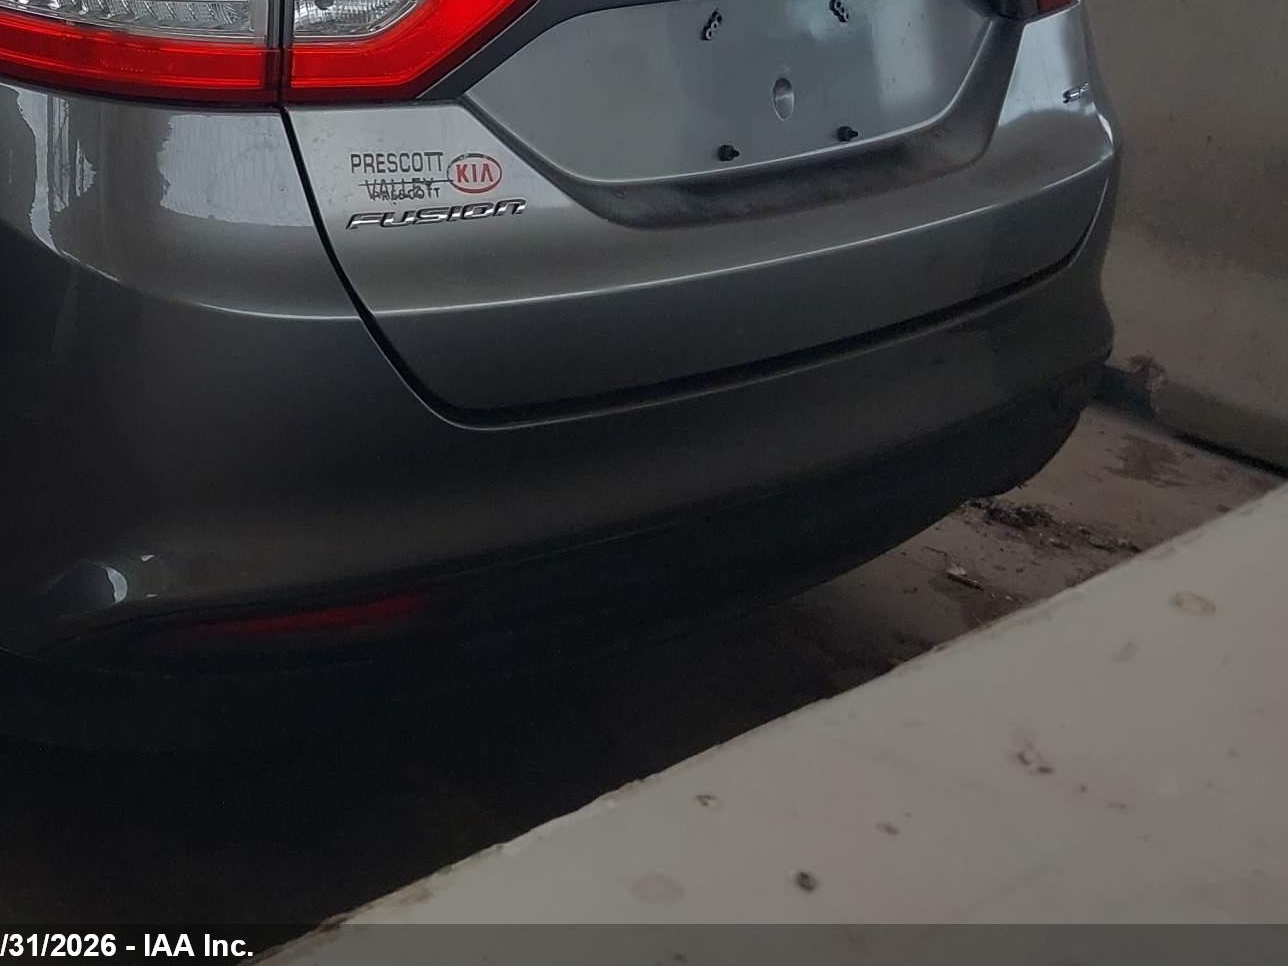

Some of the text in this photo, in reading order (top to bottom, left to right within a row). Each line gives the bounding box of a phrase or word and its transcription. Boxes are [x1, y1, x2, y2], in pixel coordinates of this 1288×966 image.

[350, 151, 444, 174] PRESCOTT
[455, 163, 495, 183] KIA
[345, 198, 528, 231] FUSION
